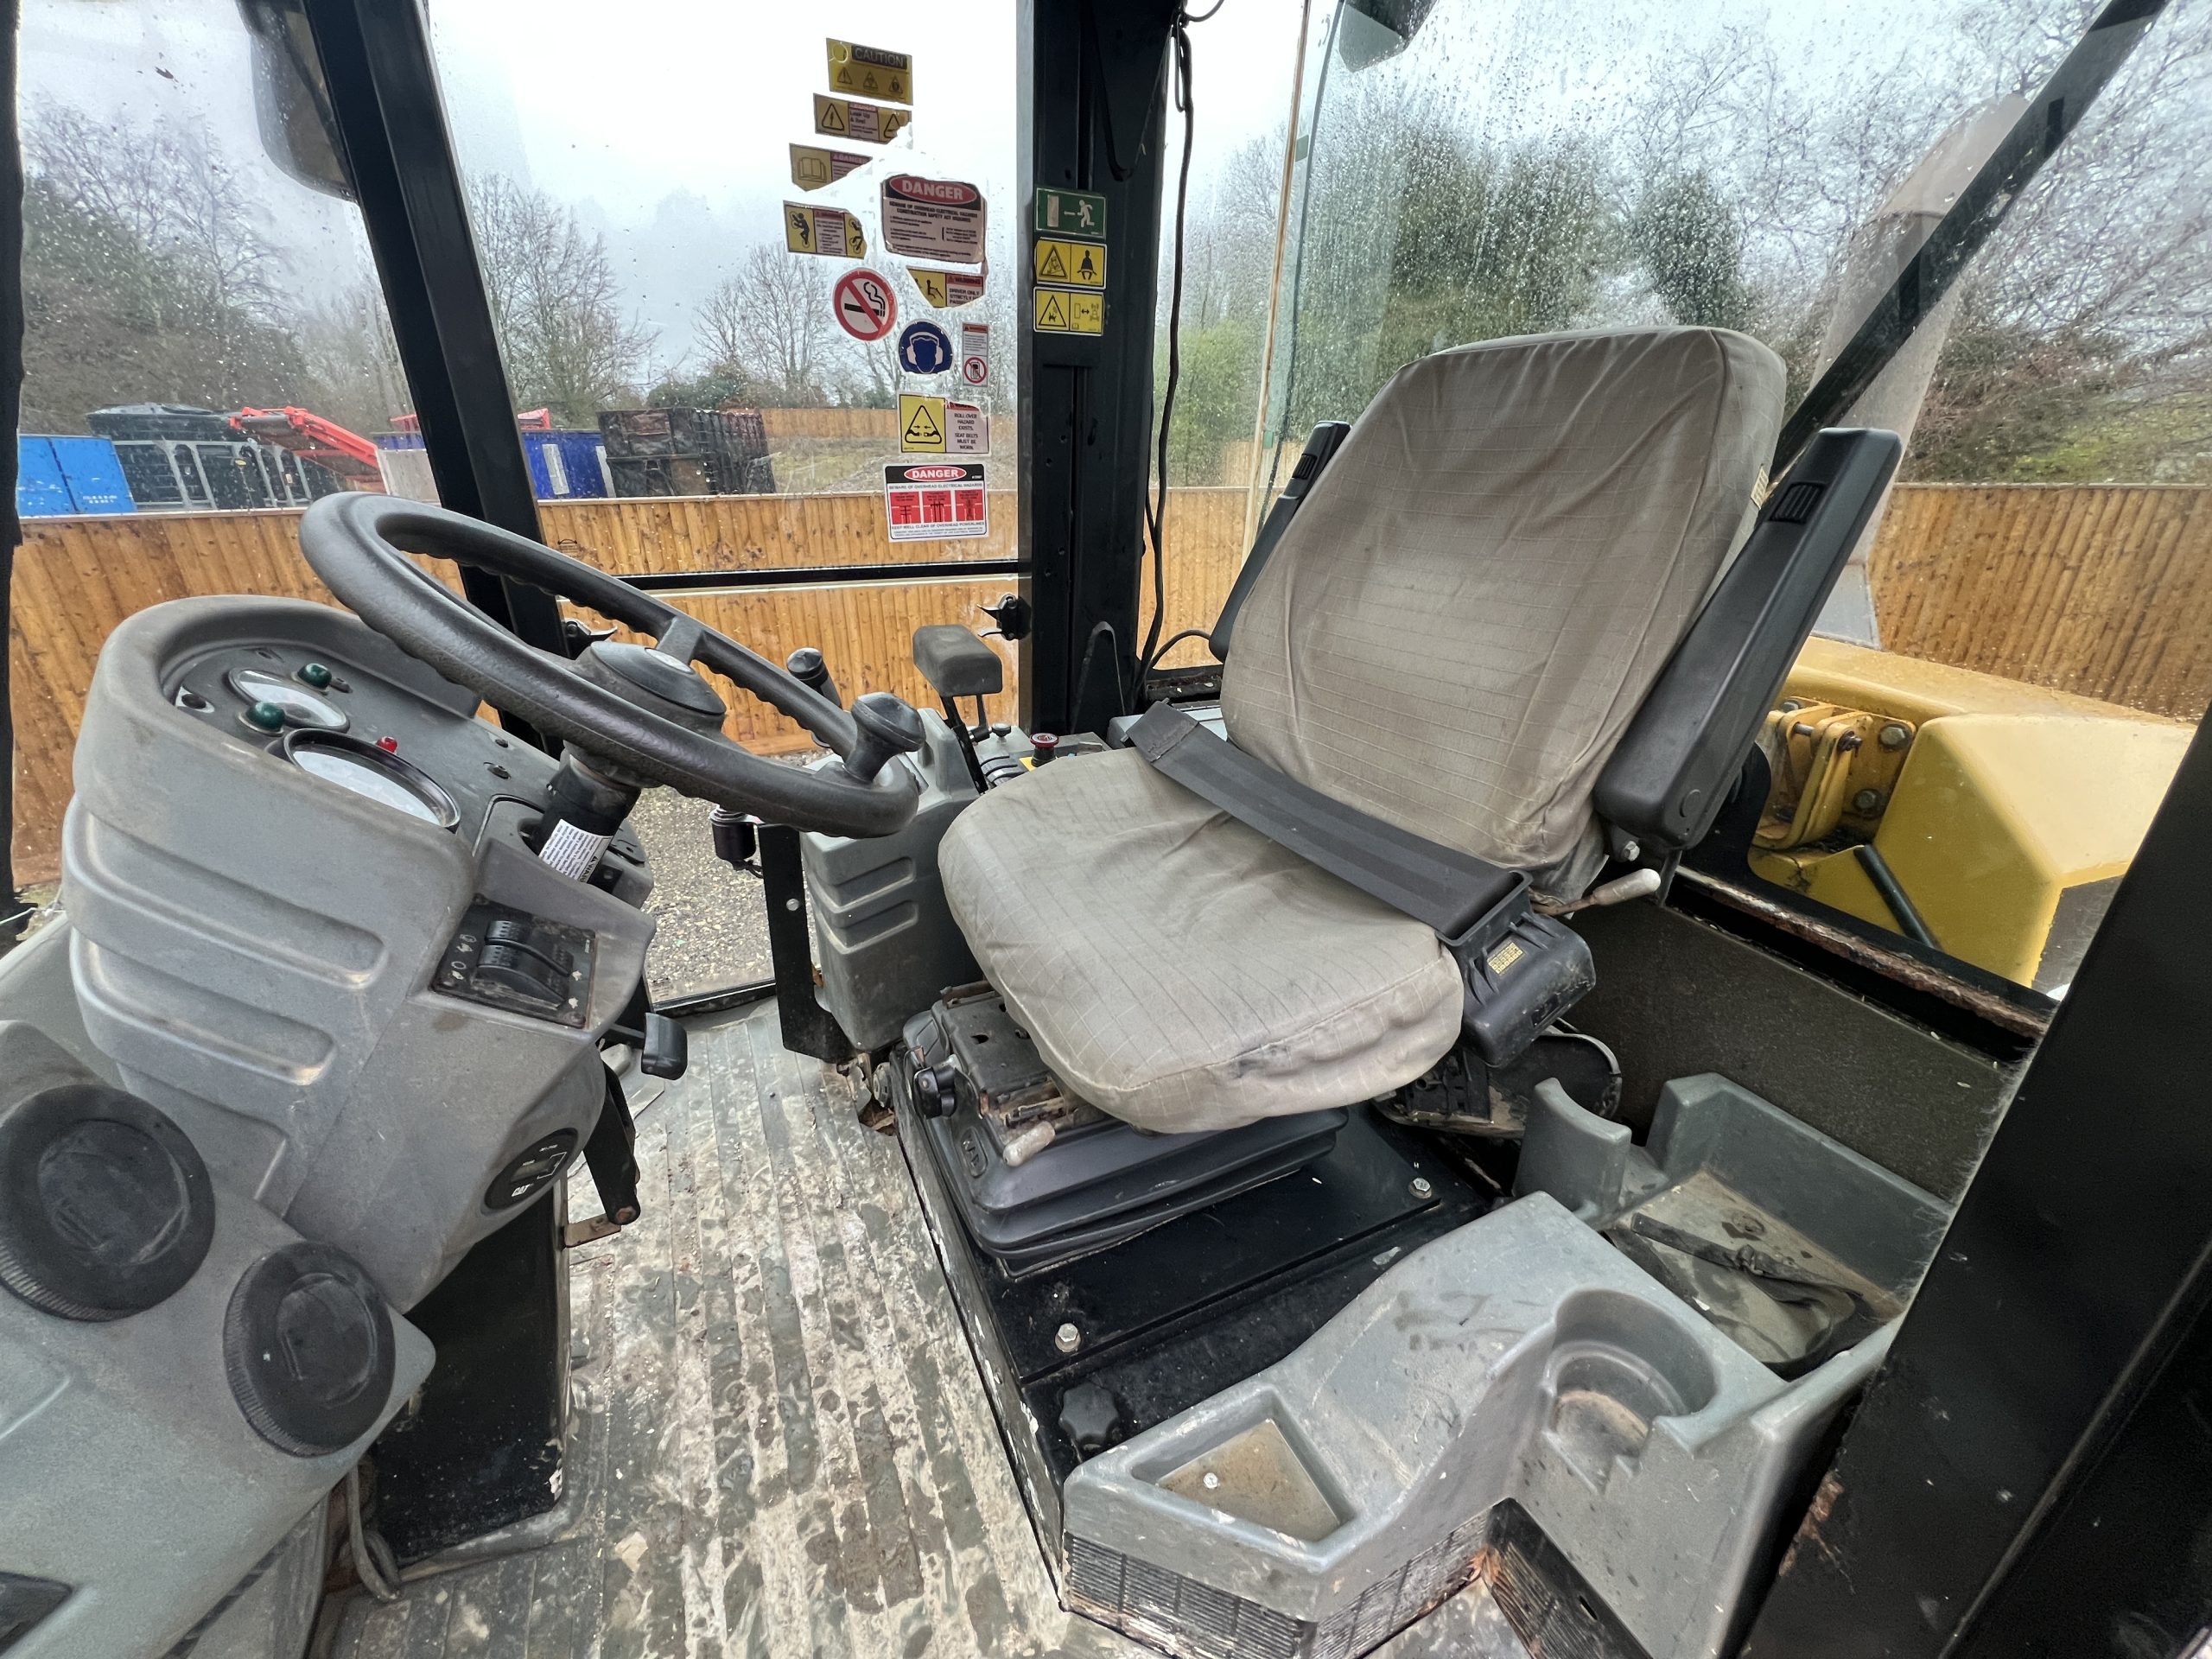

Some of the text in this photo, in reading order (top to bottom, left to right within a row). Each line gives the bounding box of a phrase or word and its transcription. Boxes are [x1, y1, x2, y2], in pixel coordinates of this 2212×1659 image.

[855, 48, 904, 67] CAUTION
[902, 180, 963, 200] DANGER
[912, 469, 959, 479] DANGER
